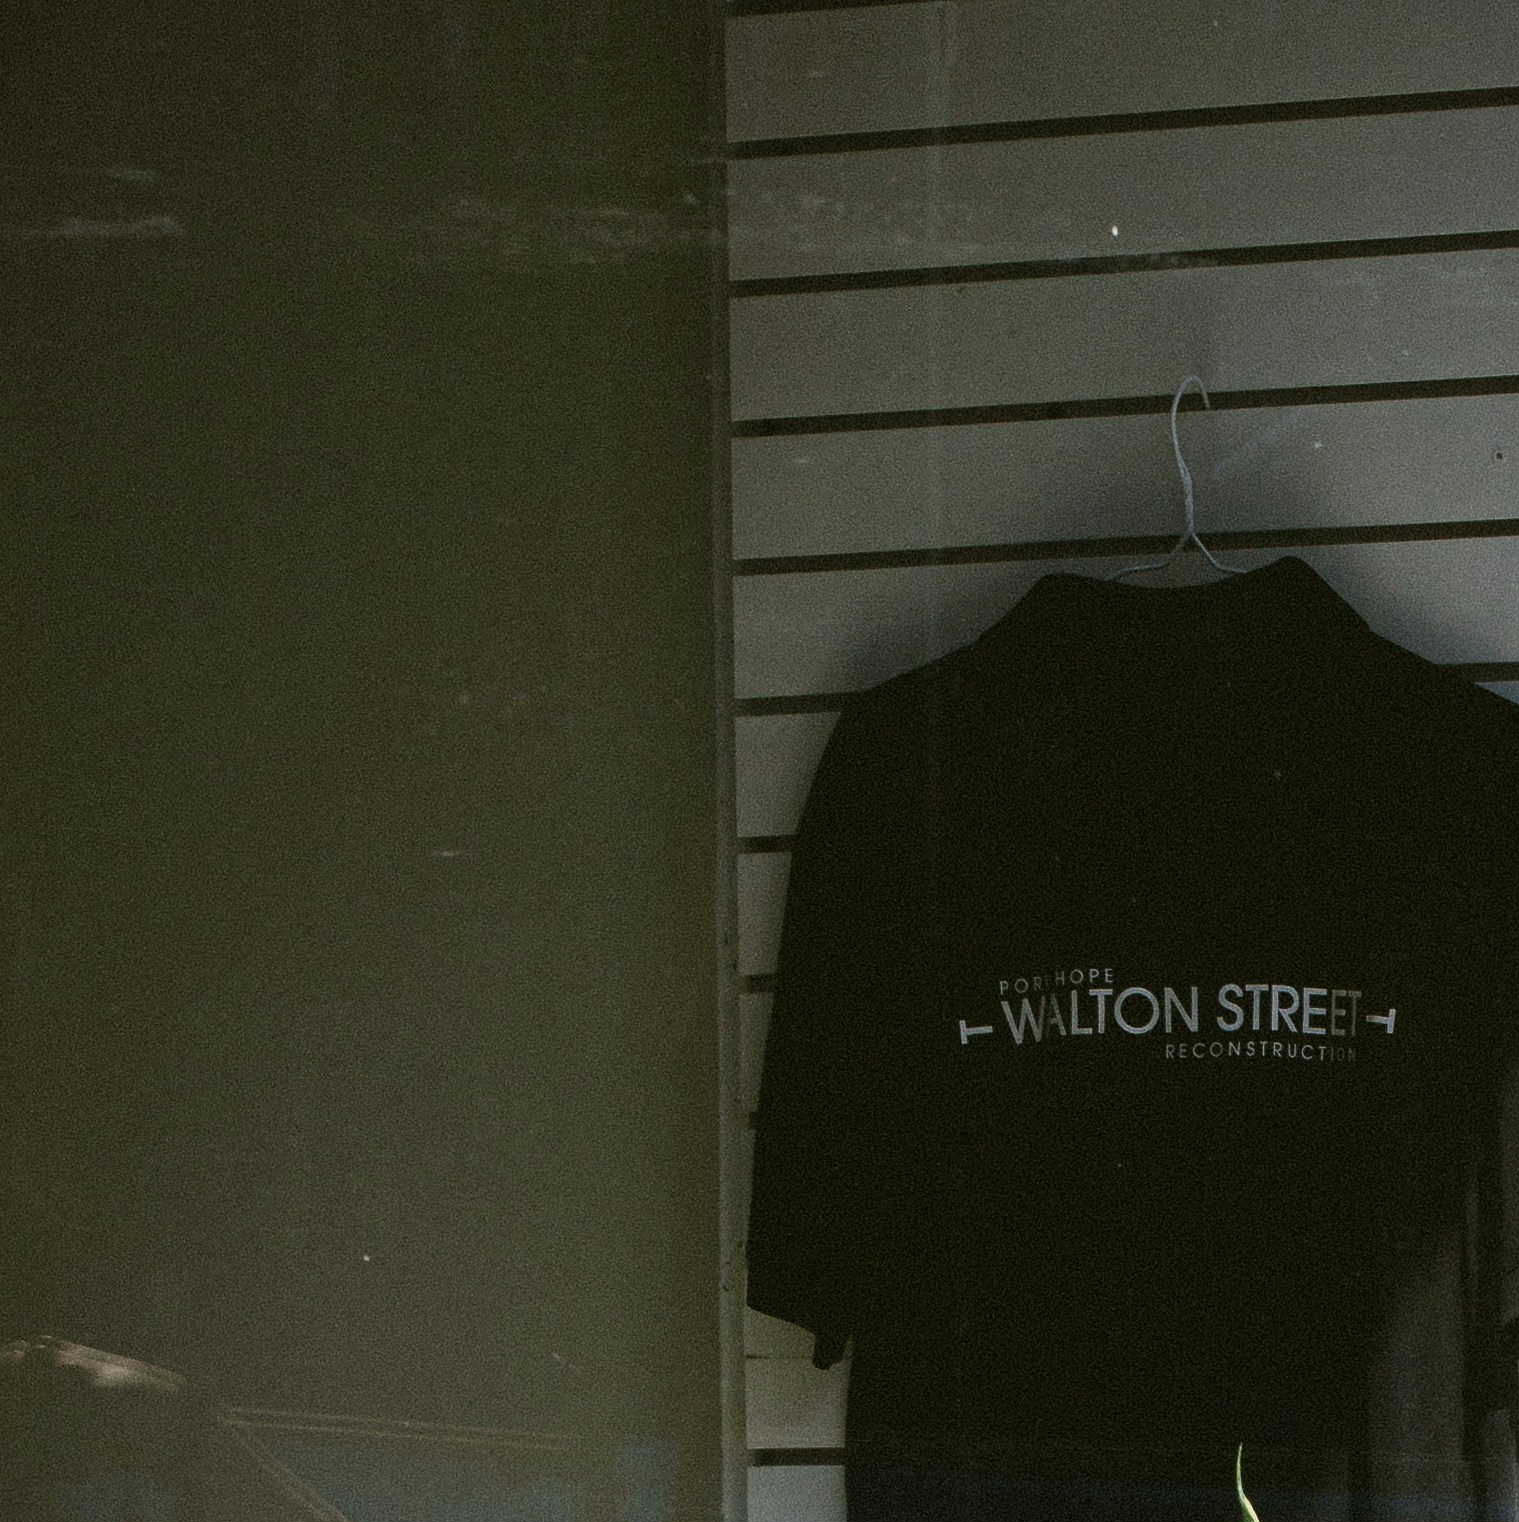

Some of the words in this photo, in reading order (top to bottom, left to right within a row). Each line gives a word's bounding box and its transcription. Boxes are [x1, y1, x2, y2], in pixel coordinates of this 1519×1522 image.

[1054, 967, 1114, 986] HOPE
[1000, 985, 1199, 1045] WALTON
[1216, 983, 1363, 1037] STREET
